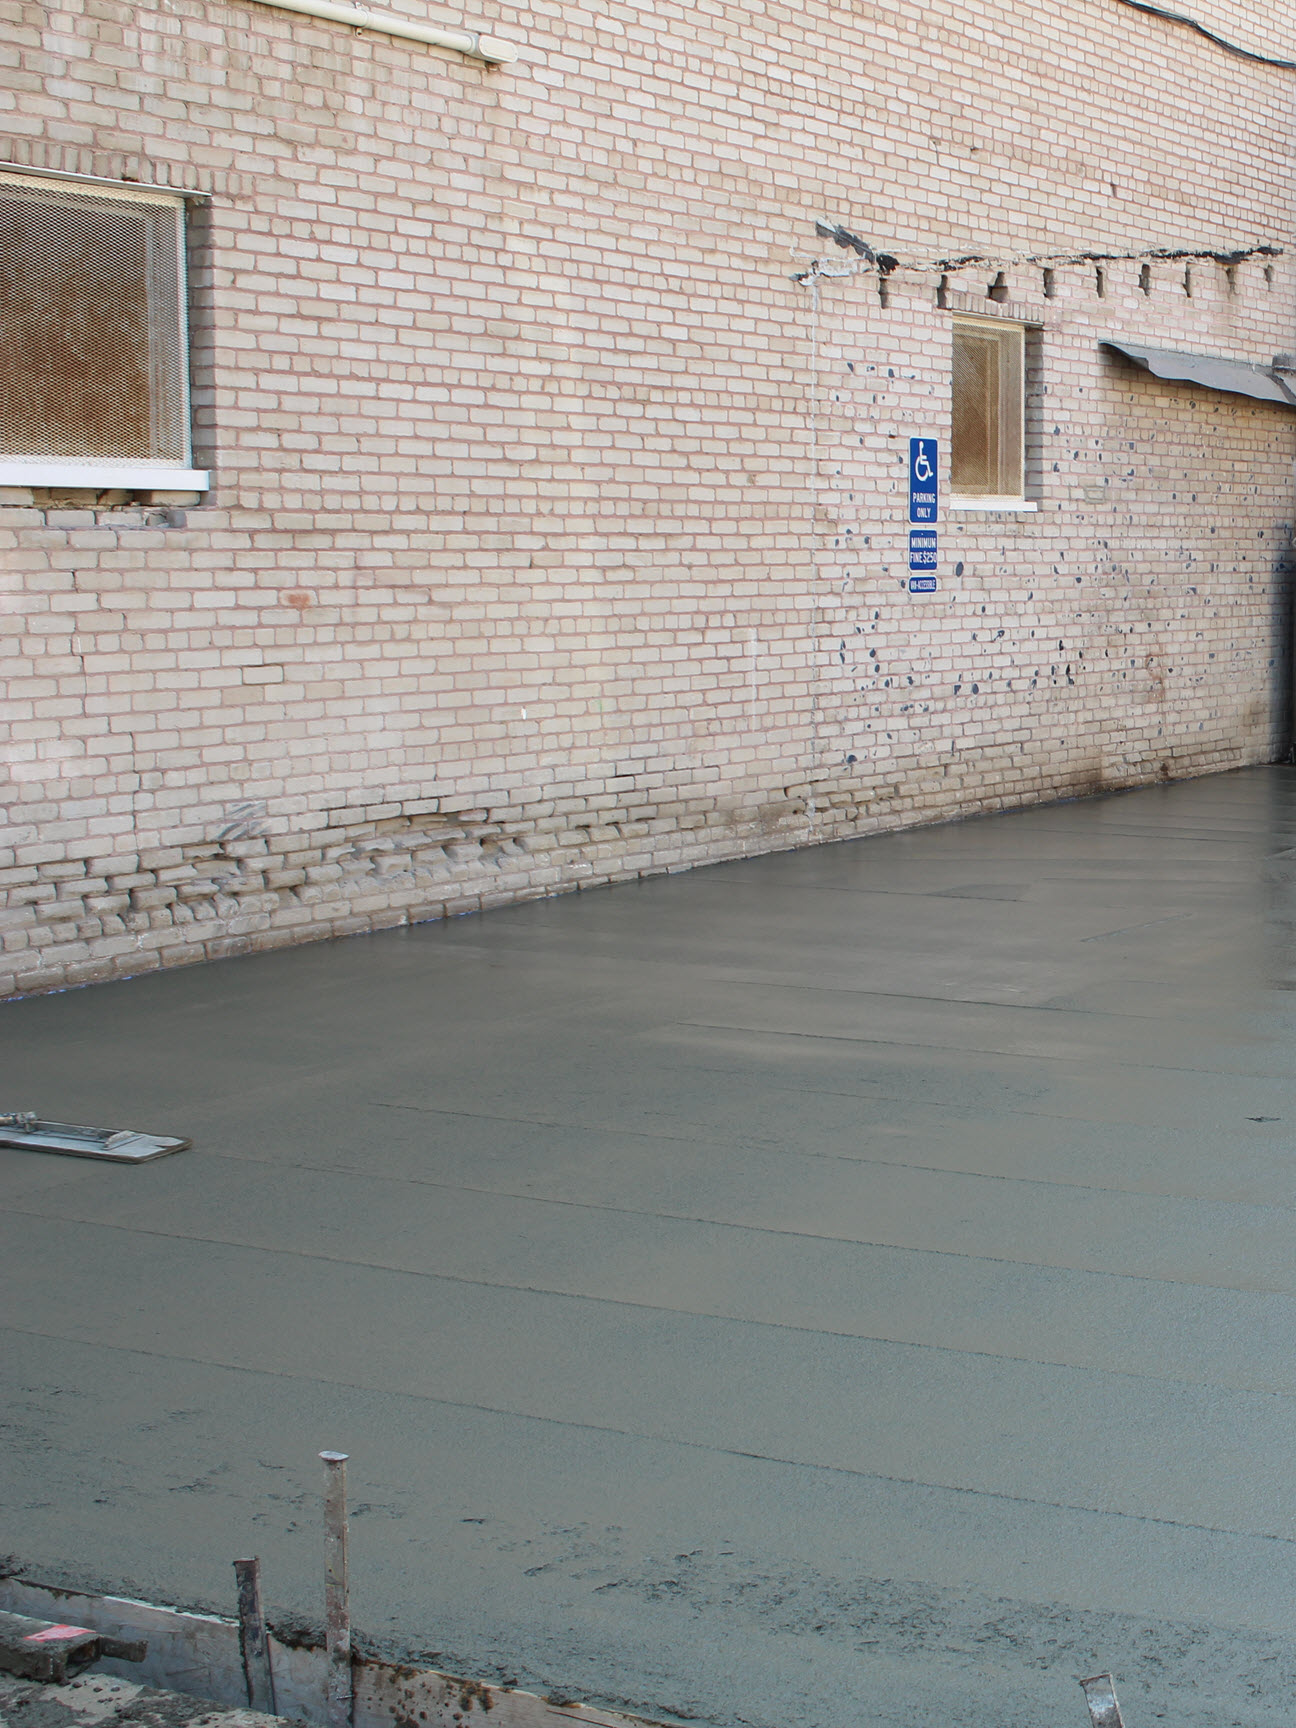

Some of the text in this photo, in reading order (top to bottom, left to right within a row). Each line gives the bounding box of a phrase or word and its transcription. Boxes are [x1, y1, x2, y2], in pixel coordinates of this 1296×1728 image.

[912, 492, 936, 503] PARKING
[916, 507, 931, 518] ONLY
[911, 537, 936, 548] MINIMUM
